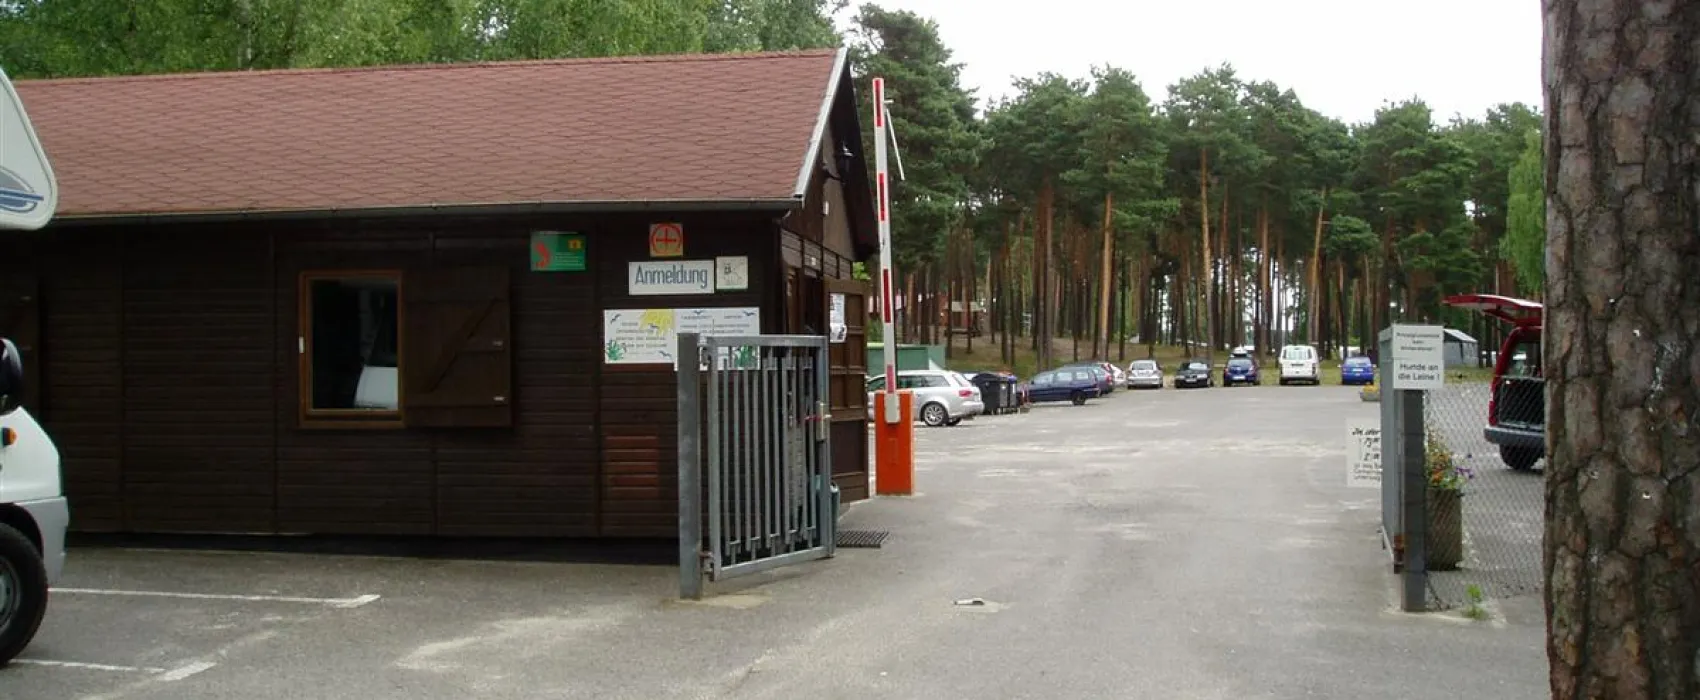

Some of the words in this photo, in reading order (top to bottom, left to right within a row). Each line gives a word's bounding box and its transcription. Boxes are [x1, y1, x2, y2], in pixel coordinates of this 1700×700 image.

[635, 264, 708, 289] Anmeldung
[1400, 363, 1425, 371] Hunde
[1398, 372, 1411, 381] die
[1413, 373, 1435, 381] Leine
